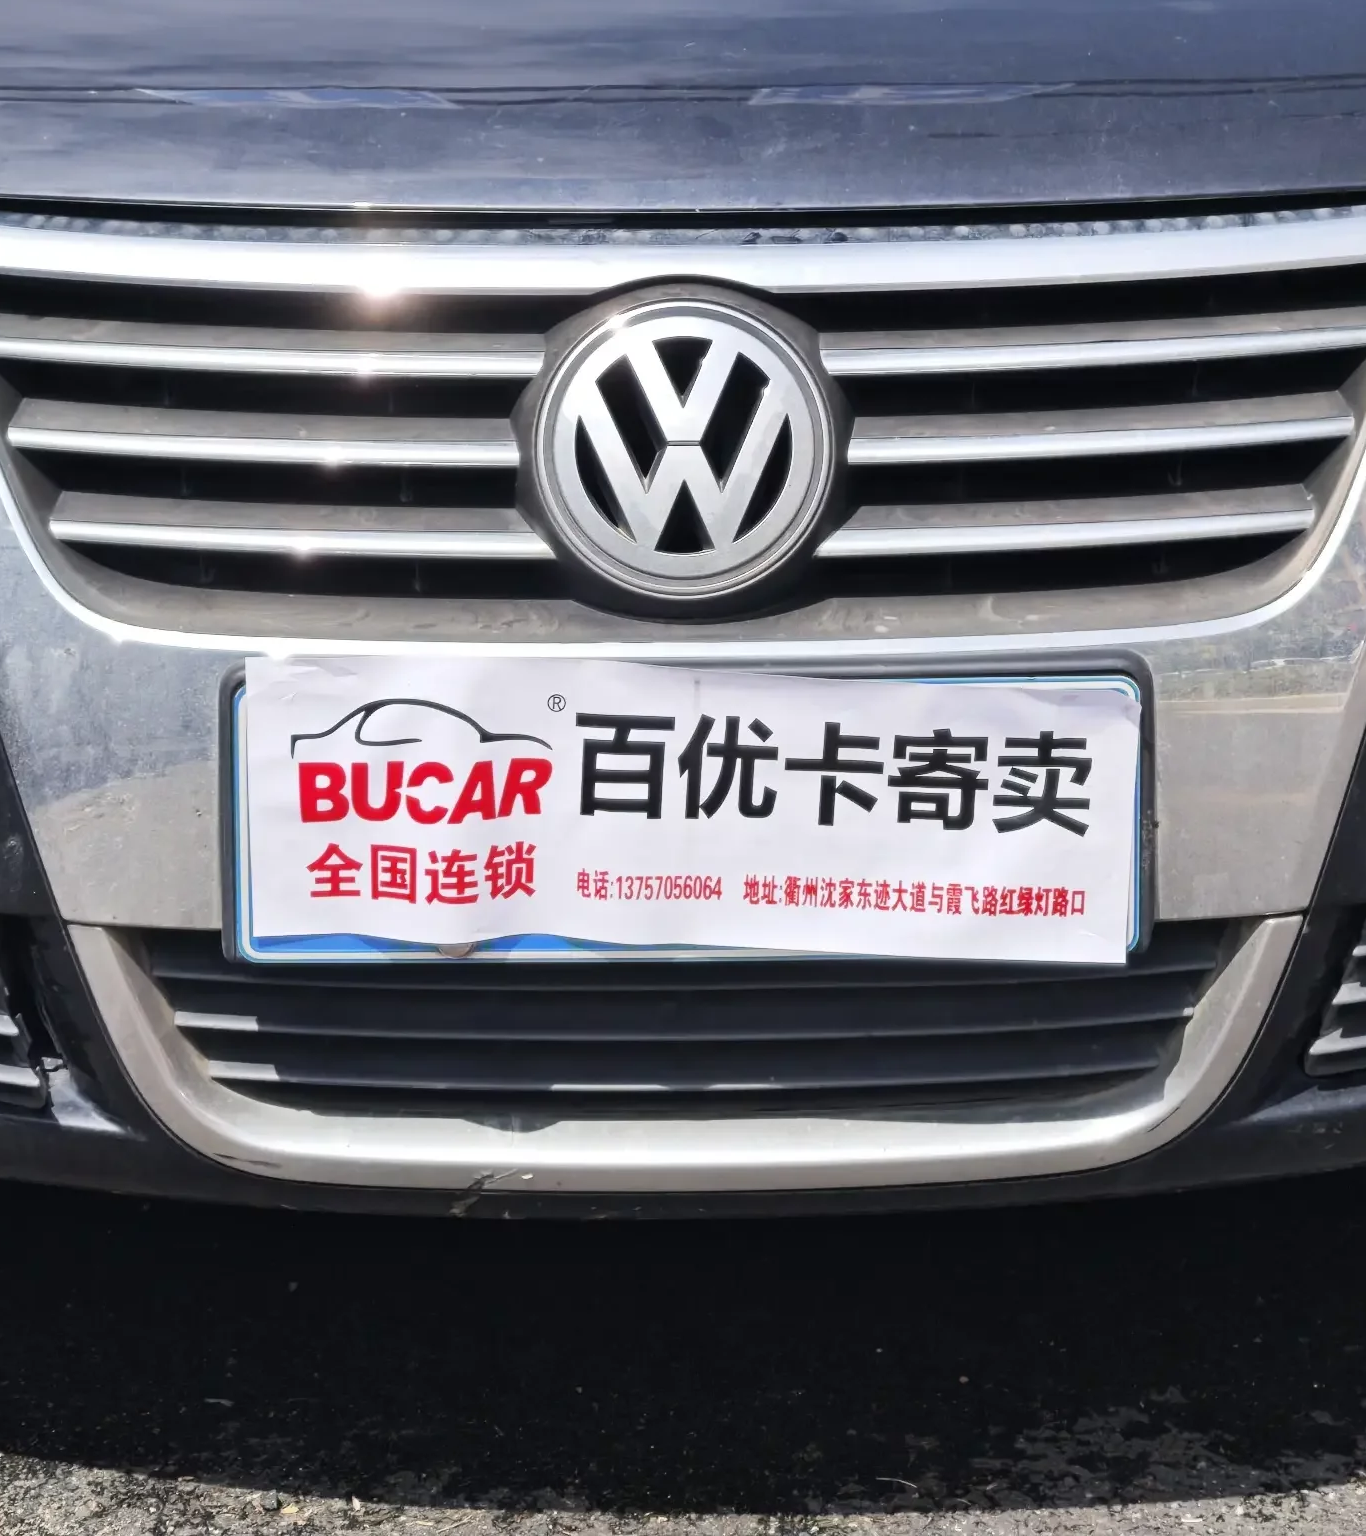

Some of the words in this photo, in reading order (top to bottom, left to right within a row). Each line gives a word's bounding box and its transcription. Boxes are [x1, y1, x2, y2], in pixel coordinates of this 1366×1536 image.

[298, 757, 553, 825] BUCAR
[575, 712, 1093, 838] 百优卡寄卖
[306, 840, 537, 905] 全国连锁
[576, 867, 723, 901] 电话:13757056064
